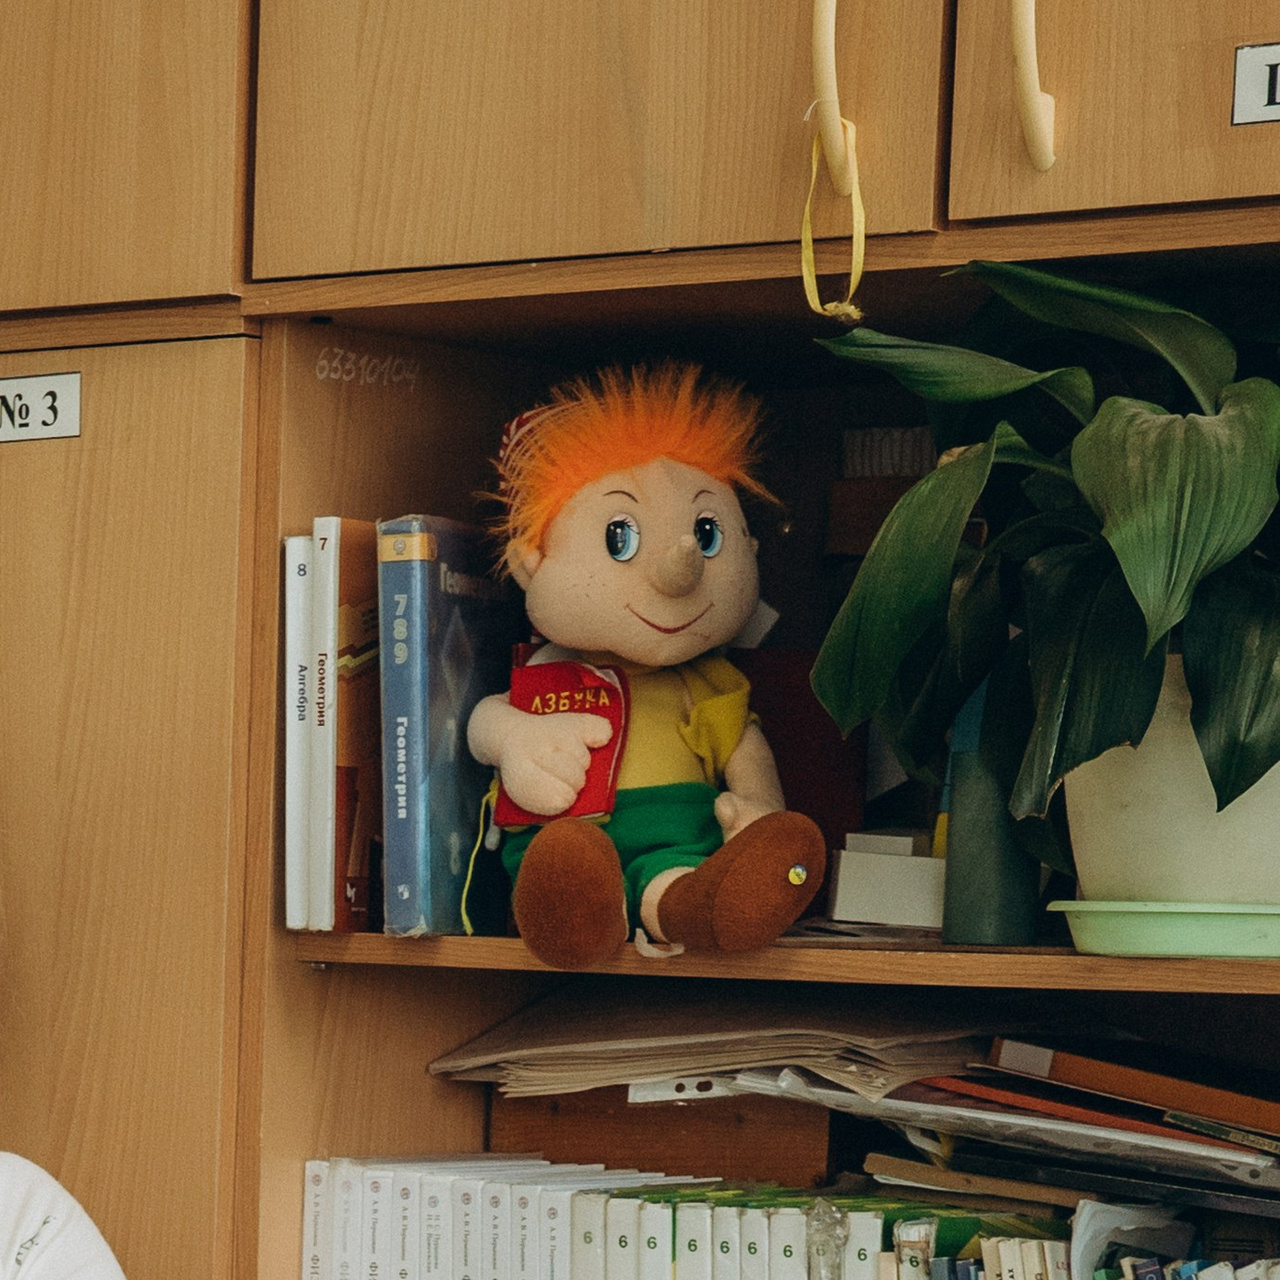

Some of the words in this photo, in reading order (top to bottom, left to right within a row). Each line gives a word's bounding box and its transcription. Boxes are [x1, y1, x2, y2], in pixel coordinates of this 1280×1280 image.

[41, 390, 58, 427] 3
[319, 537, 328, 550] 7
[297, 563, 307, 577] 8
[393, 618, 408, 640] 8
[296, 664, 308, 721] Алгебра
[316, 653, 328, 727] Геометрия
[531, 689, 610, 713] АЗБУКА
[394, 716, 408, 819] Геометрия
[583, 1231, 593, 1244] 6
[618, 1235, 628, 1248] 6
[646, 1236, 657, 1249] 6
[687, 1239, 698, 1252] 6
[720, 1240, 730, 1254] 6
[747, 1241, 758, 1254] 6
[783, 1245, 793, 1258] 6
[857, 1248, 867, 1261] 6
[909, 1255, 919, 1268] 6
